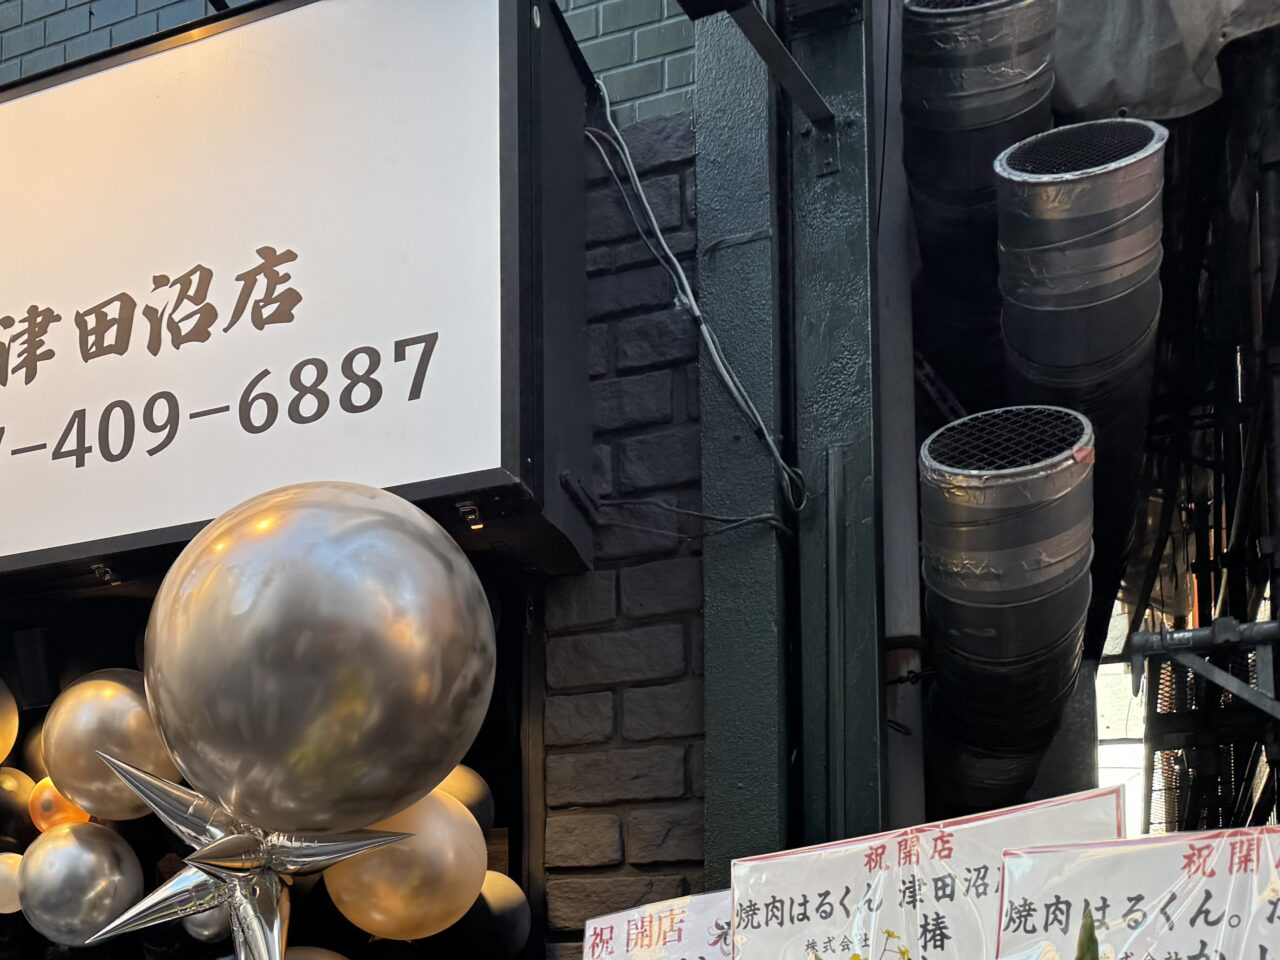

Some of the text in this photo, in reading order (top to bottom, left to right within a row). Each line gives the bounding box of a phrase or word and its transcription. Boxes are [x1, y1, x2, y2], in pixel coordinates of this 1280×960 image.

[898, 865, 1000, 908] 津田沼
[589, 909, 687, 959] 祝 開店
[918, 912, 952, 951] 椿
